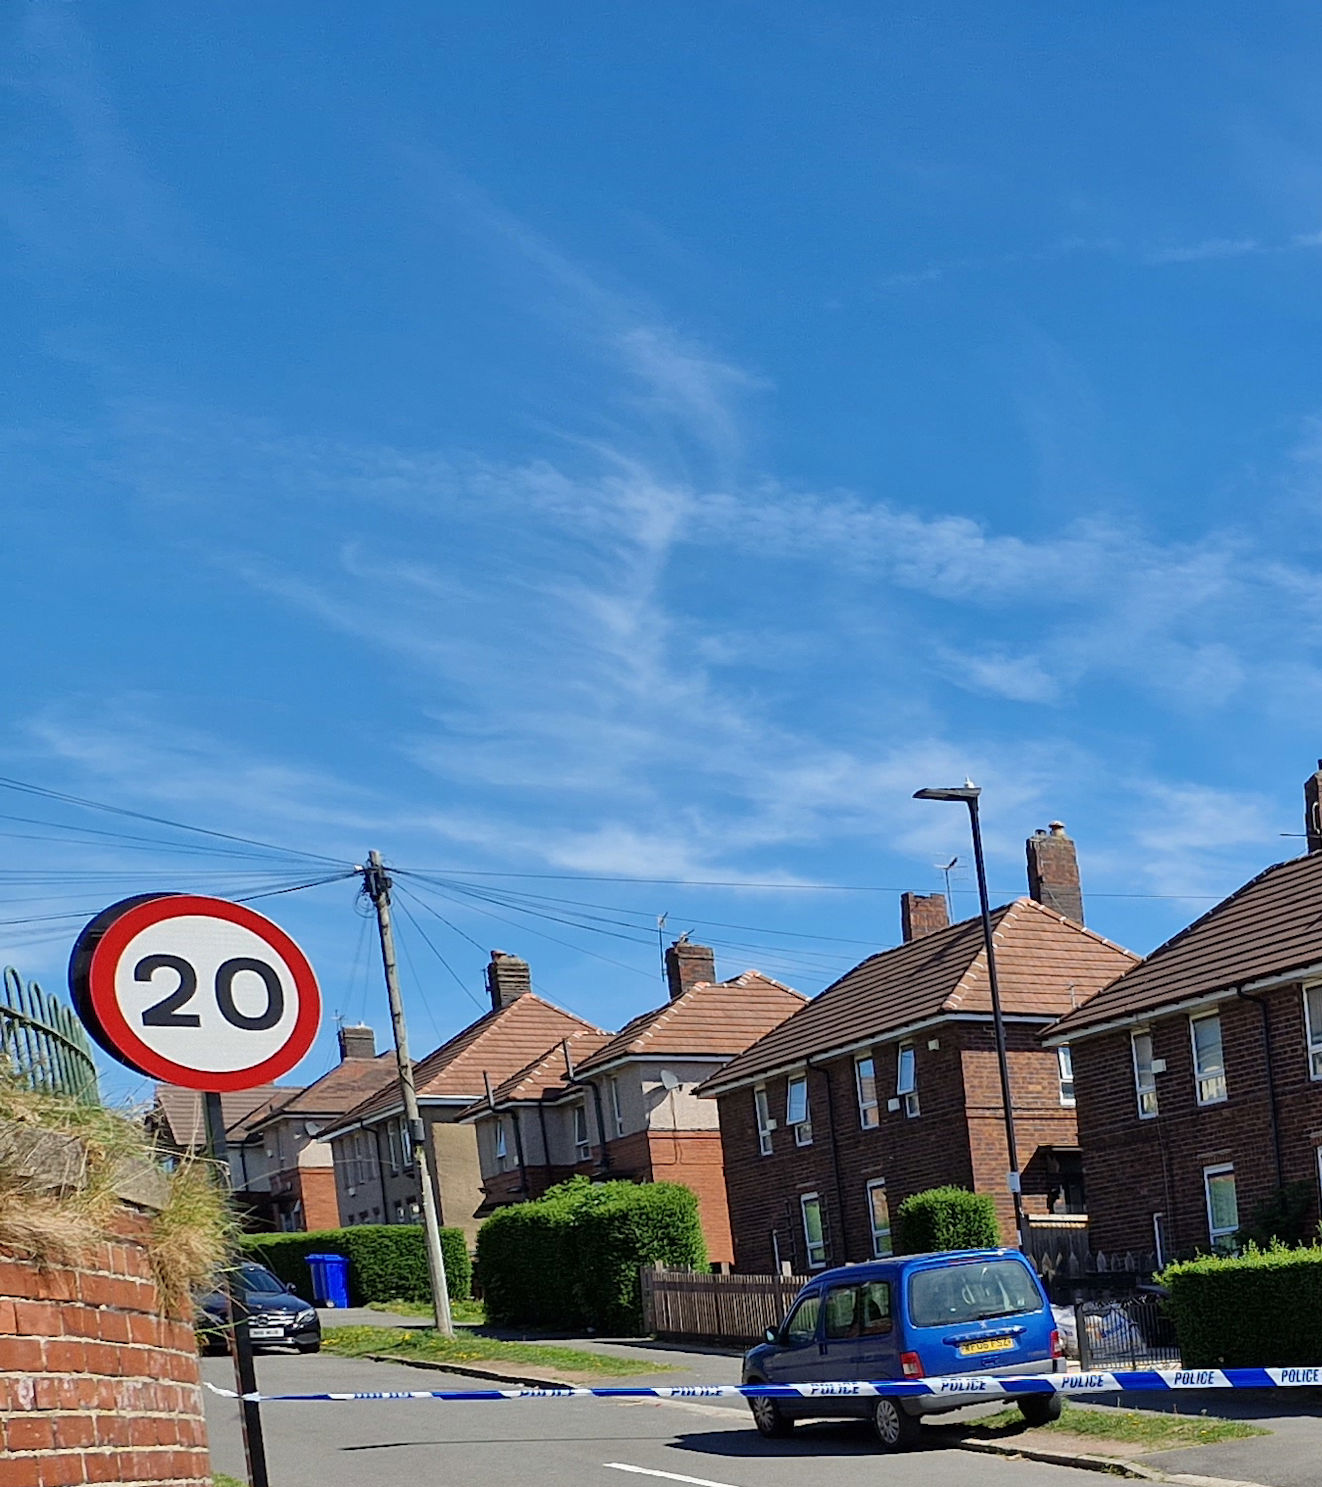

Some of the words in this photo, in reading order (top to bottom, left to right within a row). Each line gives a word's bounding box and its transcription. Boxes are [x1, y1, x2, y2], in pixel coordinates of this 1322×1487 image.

[134, 954, 284, 1030] 20
[1061, 1374, 1104, 1389] POLICE
[1174, 1369, 1215, 1385] POLICE
[1281, 1368, 1319, 1383] POLICE
